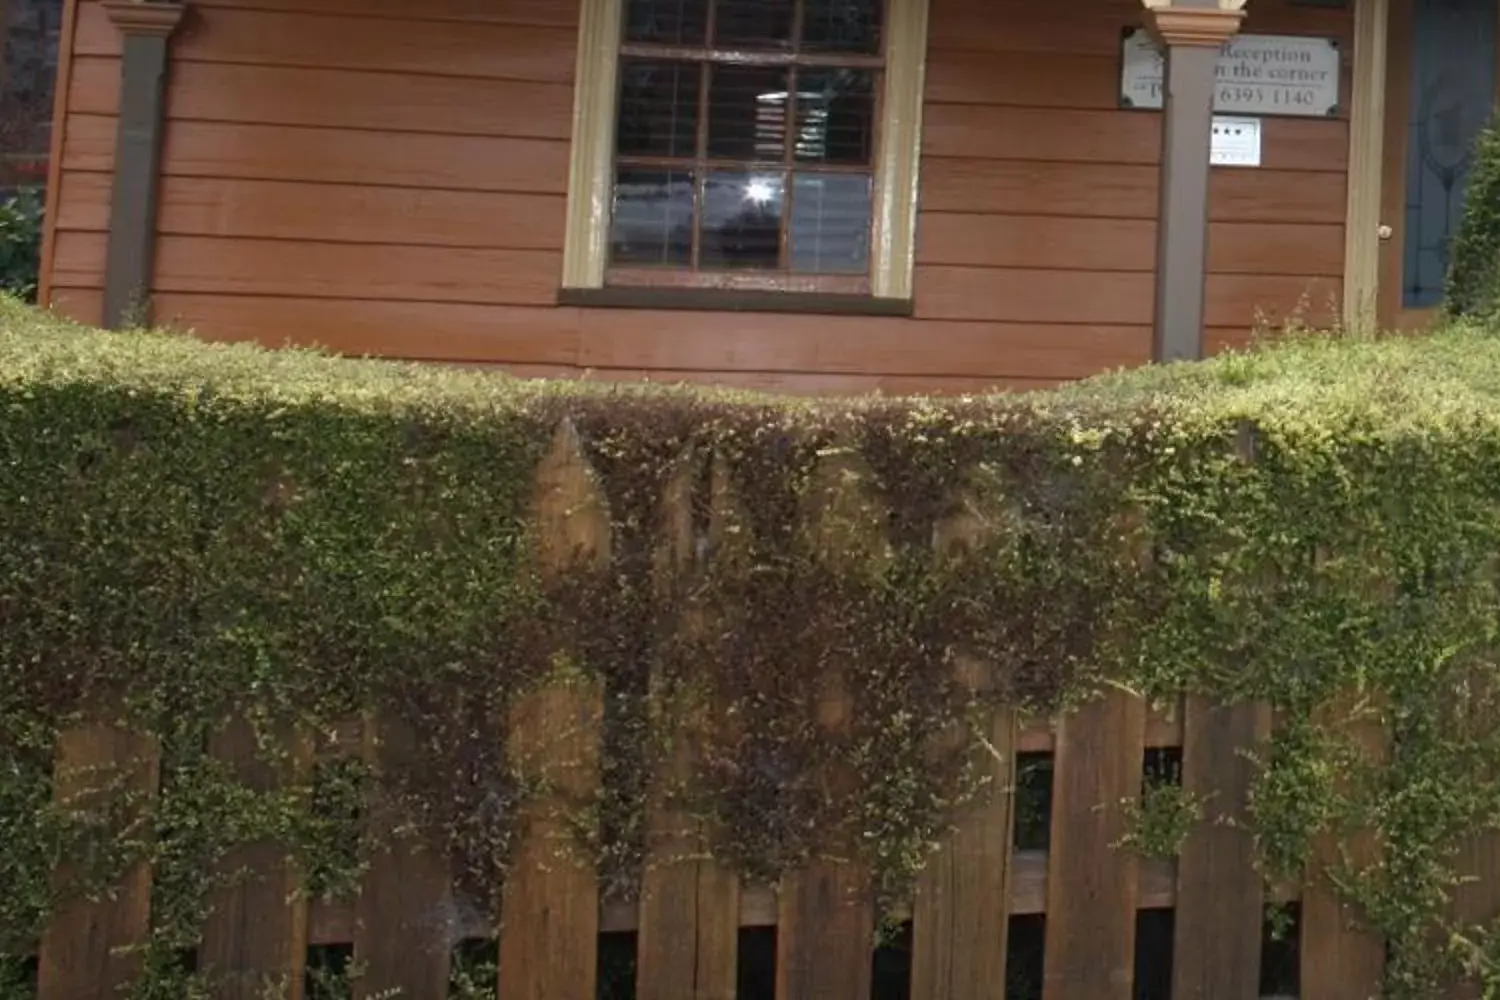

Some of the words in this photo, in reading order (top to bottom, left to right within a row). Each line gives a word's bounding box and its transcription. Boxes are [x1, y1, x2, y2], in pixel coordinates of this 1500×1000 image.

[1219, 43, 1311, 64] Reception
[1233, 60, 1262, 78] the
[1267, 68, 1329, 81] corner
